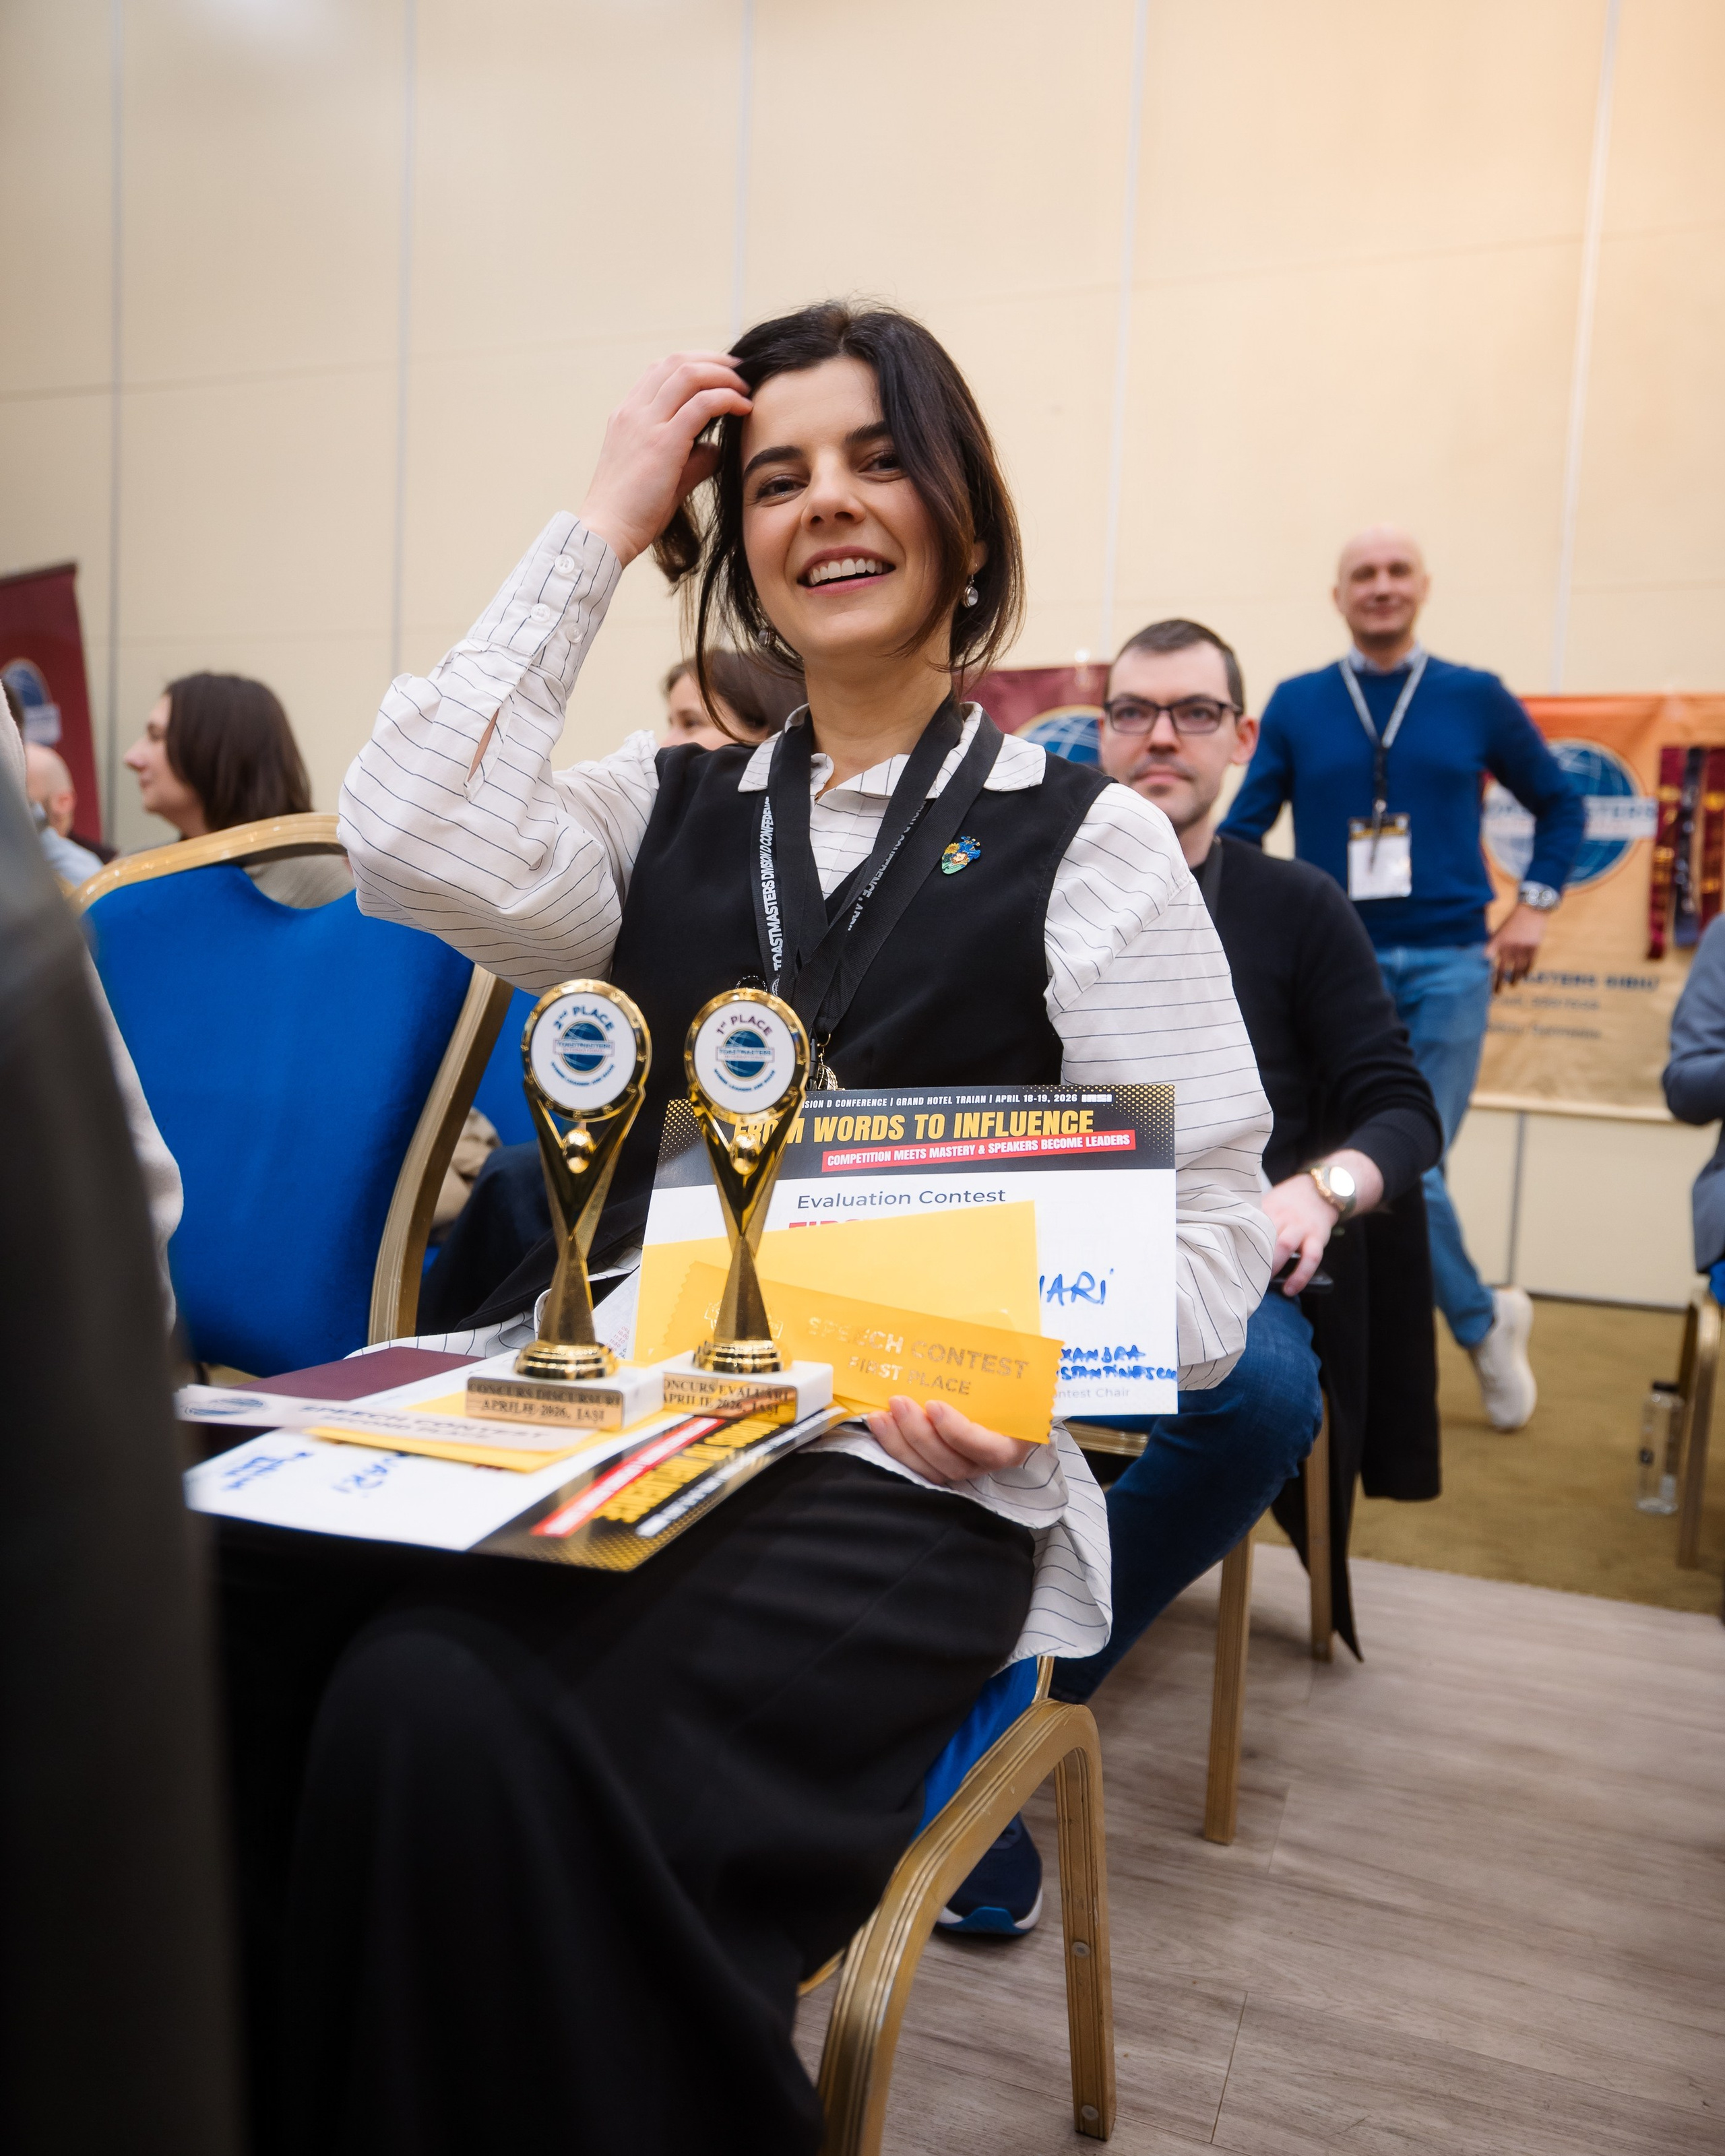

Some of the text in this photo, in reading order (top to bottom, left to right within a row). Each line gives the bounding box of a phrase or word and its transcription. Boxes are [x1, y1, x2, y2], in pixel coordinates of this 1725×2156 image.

[760, 845, 772, 854] D
[760, 850, 774, 881] DIVISION
[761, 880, 784, 971] TOASTMASTERS
[573, 1005, 614, 1032] PLACE
[730, 1015, 773, 1037] PLACE
[801, 1100, 824, 1110] ISION
[826, 1099, 833, 1108] D
[835, 1098, 887, 1108] CONFERENCE
[896, 1096, 924, 1106] GRAND
[927, 1095, 953, 1105] HOTEL
[955, 1095, 986, 1104] TRAIAN
[995, 1094, 1021, 1104] APRIL
[1023, 1093, 1051, 1104] 18-19,
[1054, 1093, 1078, 1103] 2026
[813, 1114, 906, 1143] WORDS
[914, 1113, 945, 1140] TO
[953, 1110, 1095, 1139] INFLUENCE
[827, 1134, 1131, 1167] COMPETITION MEETS MASTERY & SPEAKERS BECOME LEADERS
[797, 1189, 1006, 1210] Evaluation Contest
[808, 1316, 904, 1355] SPEECH
[911, 1340, 1030, 1380] CONTEST
[1060, 1345, 1147, 1364] XANDRA
[664, 1378, 715, 1394] ONCURS
[848, 1356, 972, 1395] FIRST PLACE
[1053, 1387, 1131, 1399] ntest Chair
